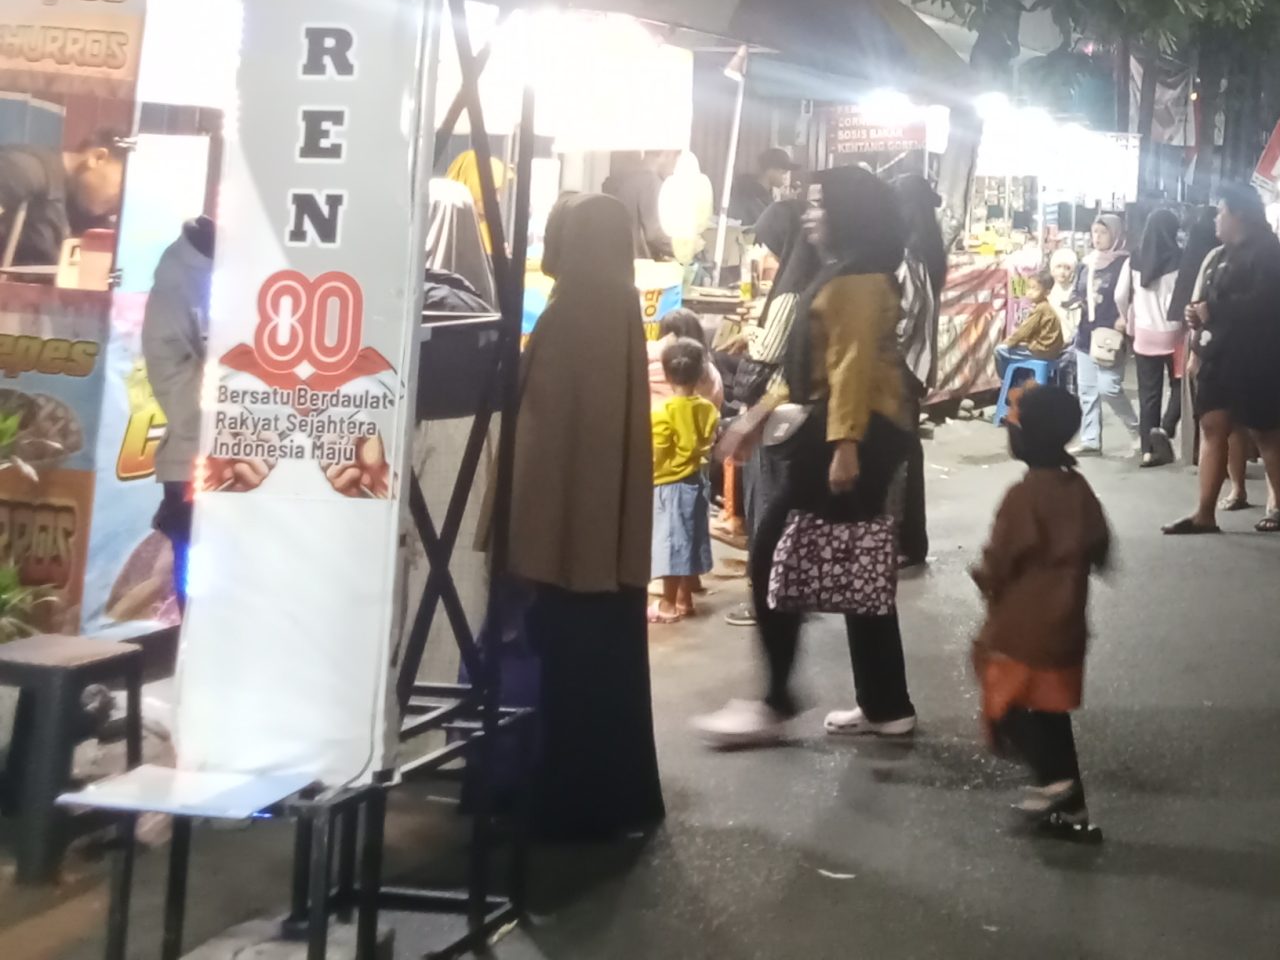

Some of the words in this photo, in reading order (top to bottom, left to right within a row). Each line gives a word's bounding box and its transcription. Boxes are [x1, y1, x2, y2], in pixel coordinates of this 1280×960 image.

[253, 269, 365, 376] 80
[217, 384, 292, 407] Bersatu
[297, 387, 391, 411] Berdaulat
[215, 411, 280, 434] Rakyat
[286, 414, 377, 438] Sejahtera
[212, 437, 306, 460] Indonesia
[310, 440, 356, 463] Maju
